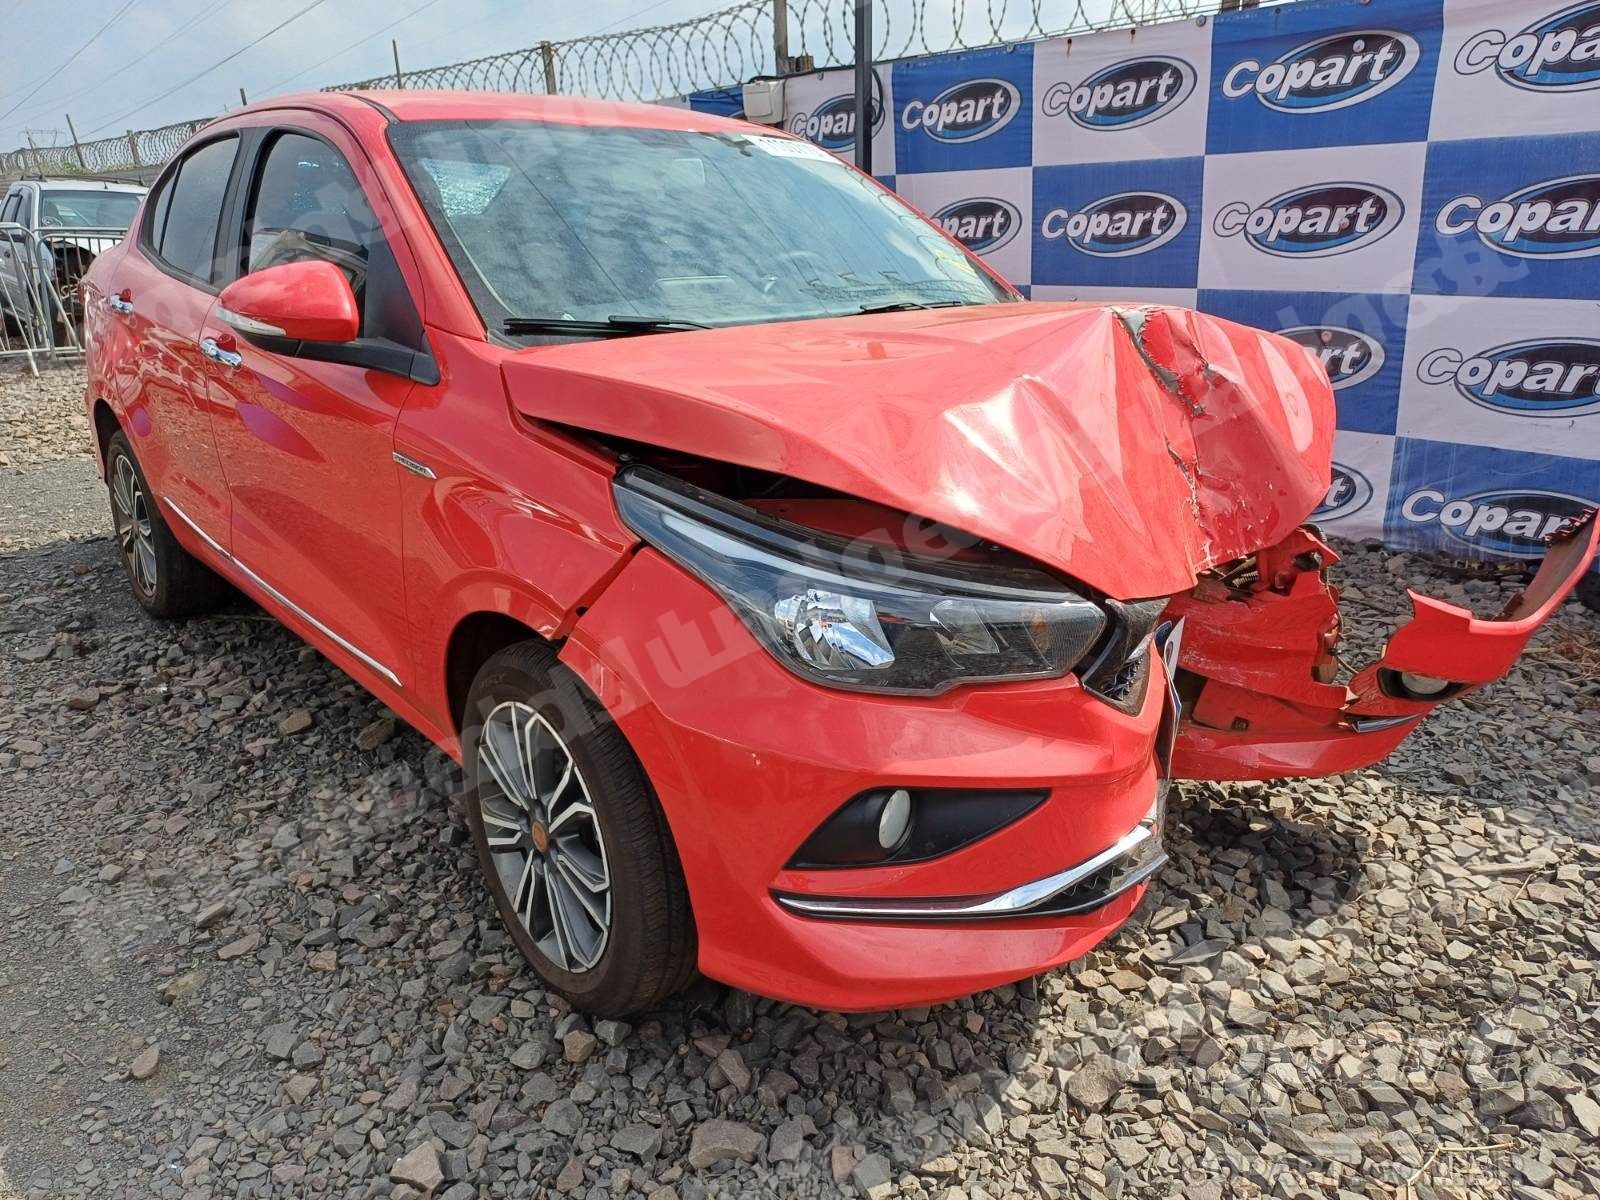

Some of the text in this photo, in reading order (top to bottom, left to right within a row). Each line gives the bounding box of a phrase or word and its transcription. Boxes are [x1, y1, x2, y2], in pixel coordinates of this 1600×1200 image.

[1222, 38, 1396, 101] Copart
[1453, 25, 1600, 77] Copa
[902, 86, 1005, 131] Copart
[1041, 67, 1178, 119] Copart
[790, 111, 856, 142] Copar
[1041, 201, 1169, 245] Copart
[1213, 194, 1378, 244] Copart
[1416, 347, 1600, 397] Copar
[1401, 488, 1572, 538] Copar
